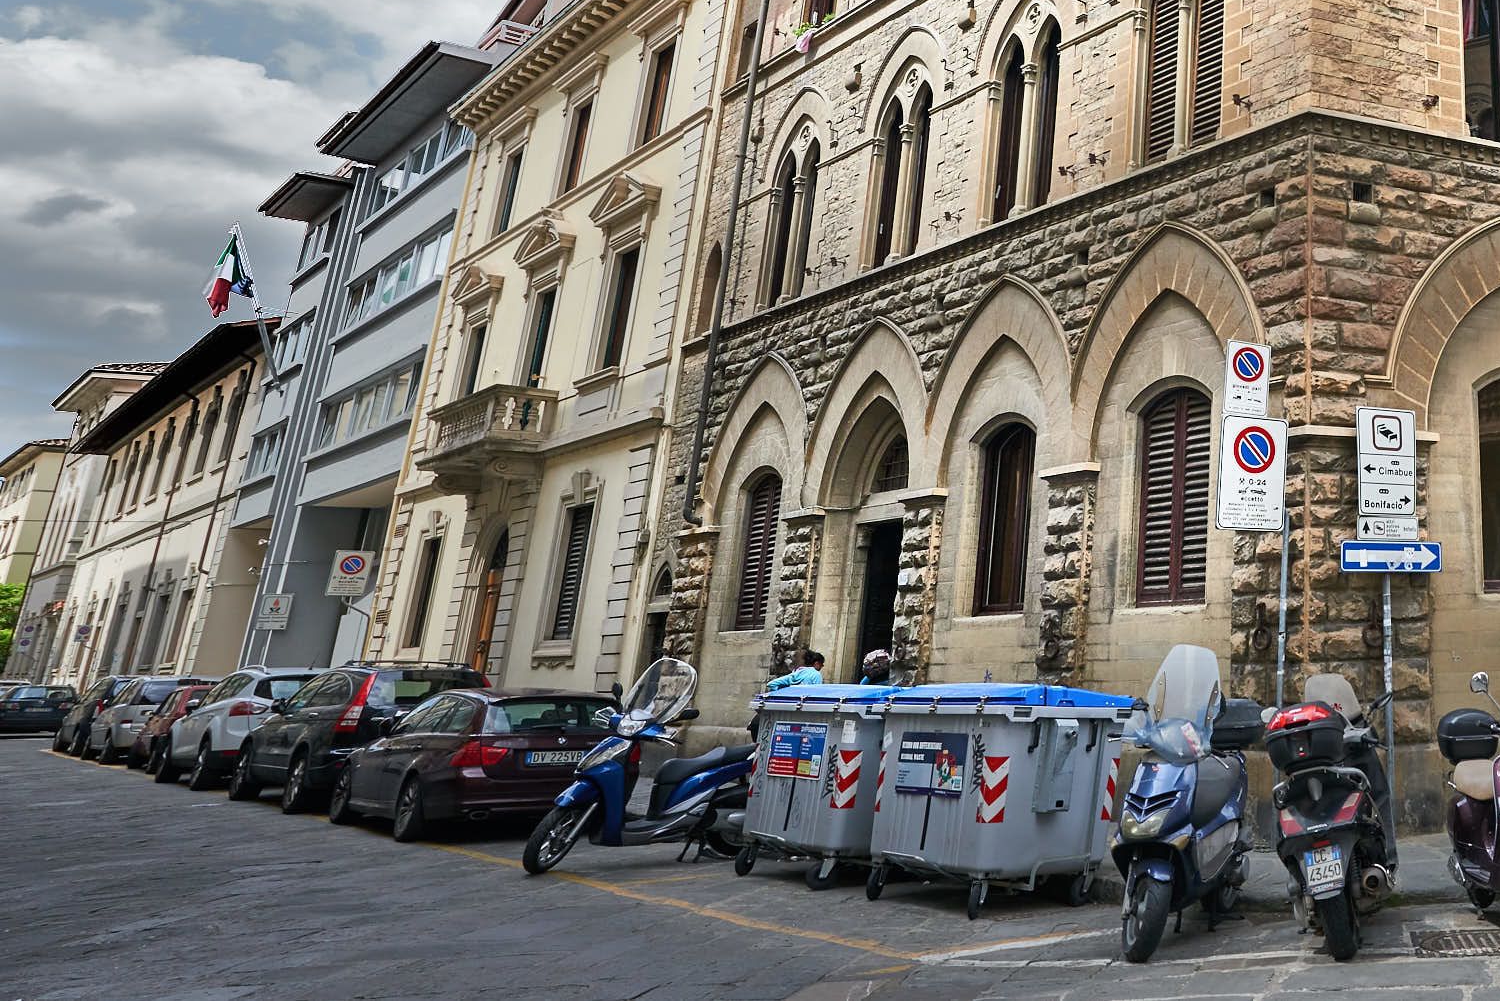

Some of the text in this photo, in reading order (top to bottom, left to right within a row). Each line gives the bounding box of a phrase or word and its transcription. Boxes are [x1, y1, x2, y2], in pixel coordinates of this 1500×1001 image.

[1378, 466, 1413, 477] Cimabue
[1364, 499, 1403, 510] Bonifacio
[532, 752, 547, 763] DV
[1313, 848, 1327, 864] CC
[1310, 863, 1341, 882] 43450
